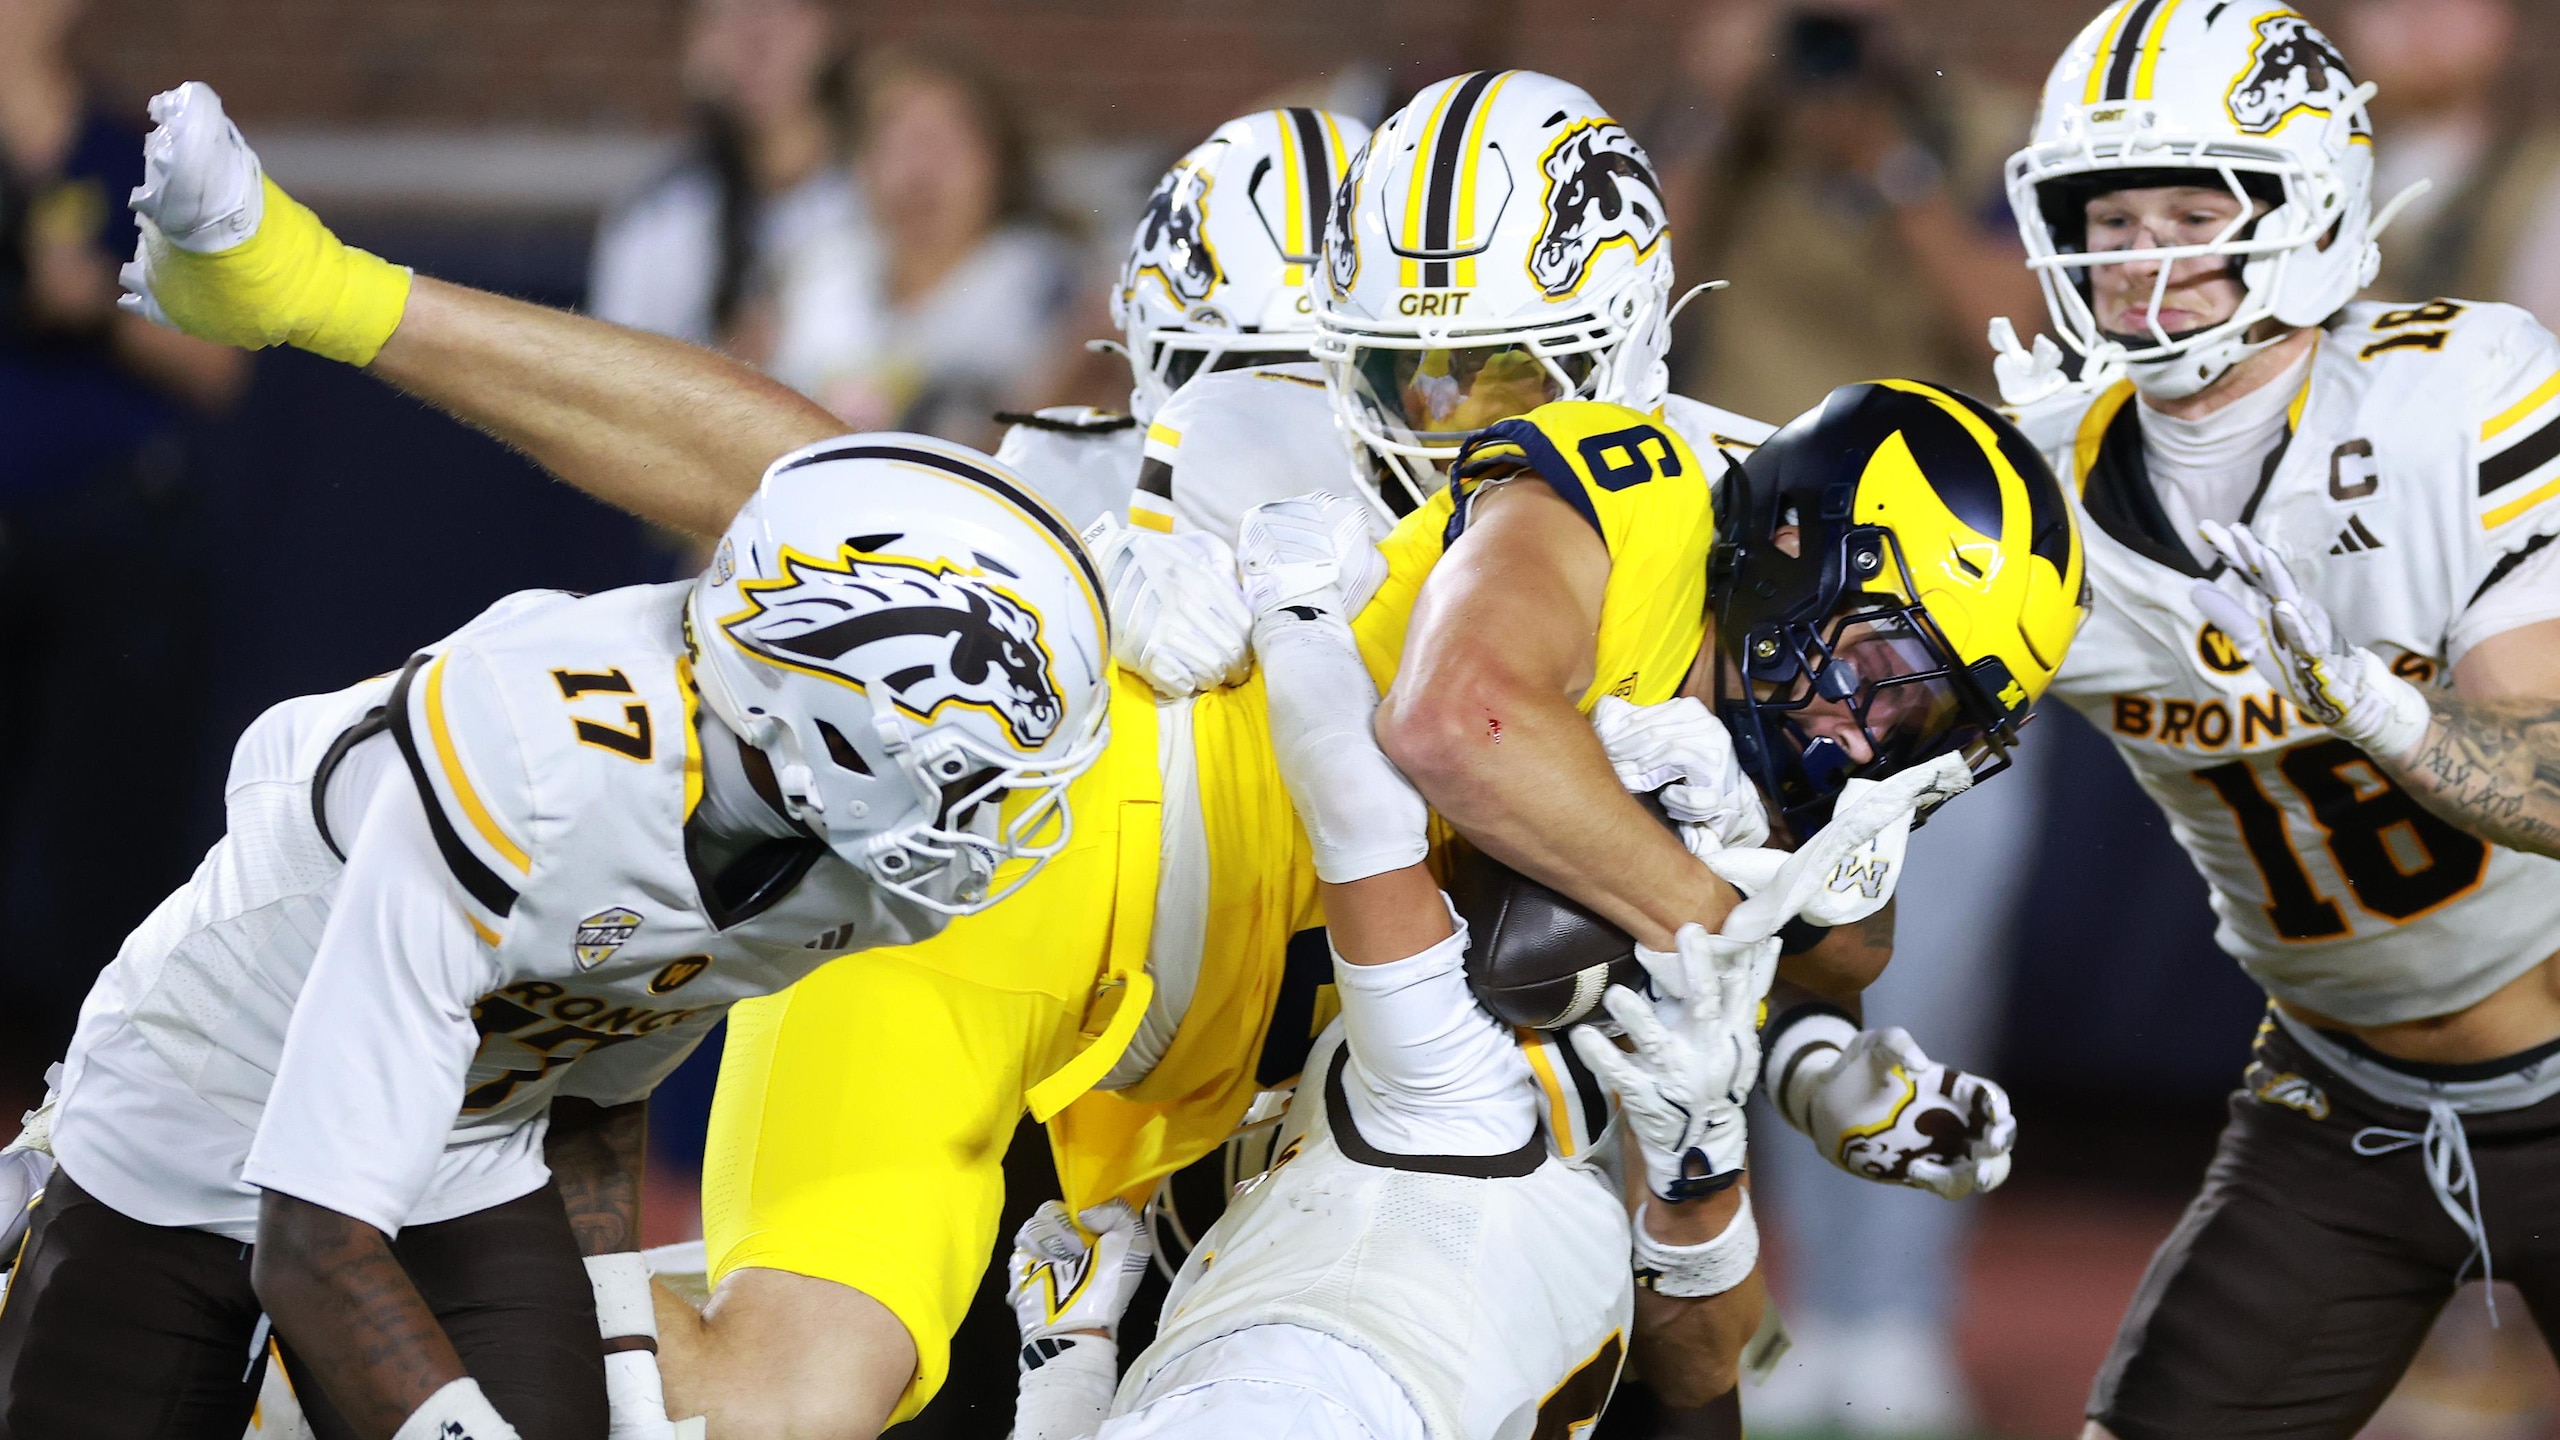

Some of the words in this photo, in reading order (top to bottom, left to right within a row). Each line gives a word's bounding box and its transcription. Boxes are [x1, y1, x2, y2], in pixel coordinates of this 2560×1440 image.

[1399, 292, 1469, 316] GRIT
[2357, 296, 2466, 361] 18
[1577, 424, 1683, 493] 6
[2329, 438, 2378, 501] C
[547, 664, 655, 764] 17
[2112, 650, 2437, 750] BRONS
[2190, 738, 2494, 944] 18
[500, 979, 702, 1037] RONC
